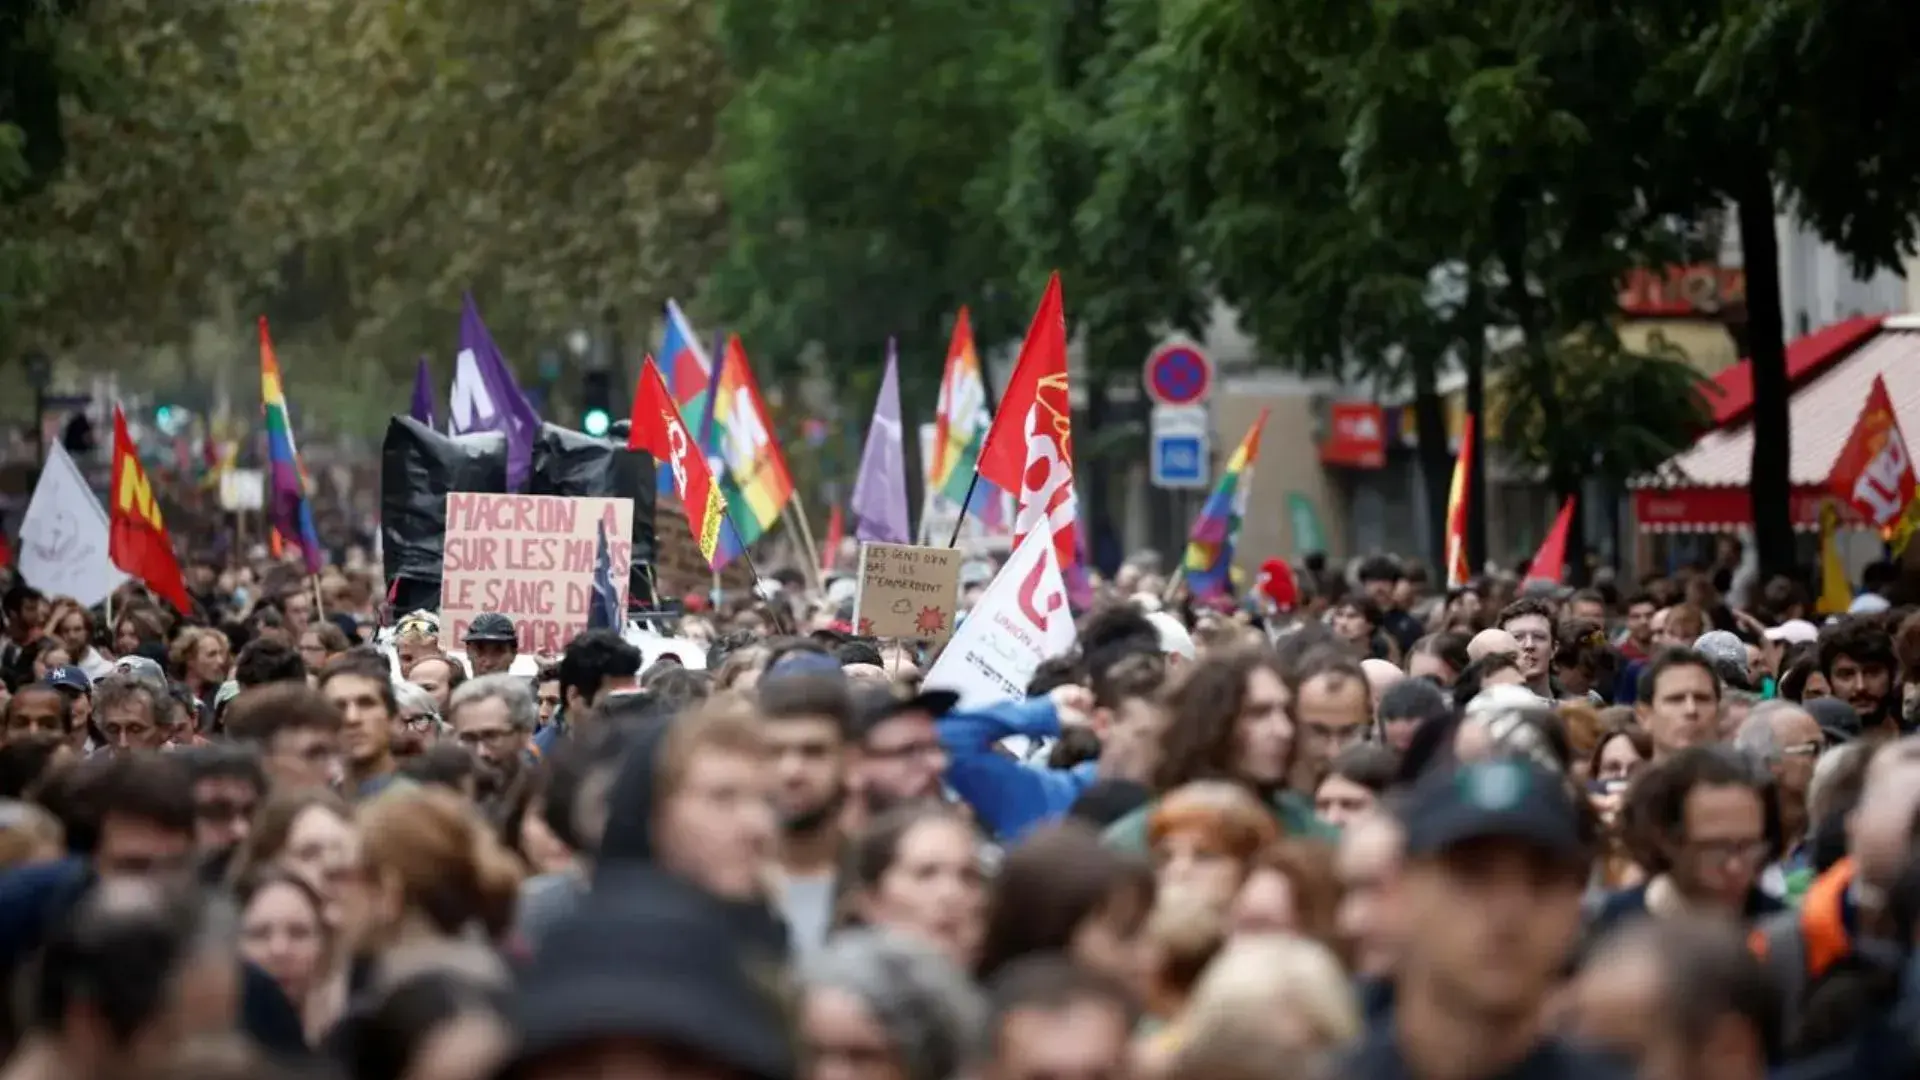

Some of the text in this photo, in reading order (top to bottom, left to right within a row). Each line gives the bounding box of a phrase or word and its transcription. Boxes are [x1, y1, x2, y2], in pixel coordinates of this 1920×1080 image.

[448, 493, 618, 536] MACRON A
[443, 538, 498, 572] SUR
[505, 538, 557, 571] LES
[866, 547, 887, 559] LES
[892, 549, 919, 562] GENS
[899, 564, 915, 575] ILS
[443, 579, 476, 610] LE
[482, 578, 555, 615] SANG
